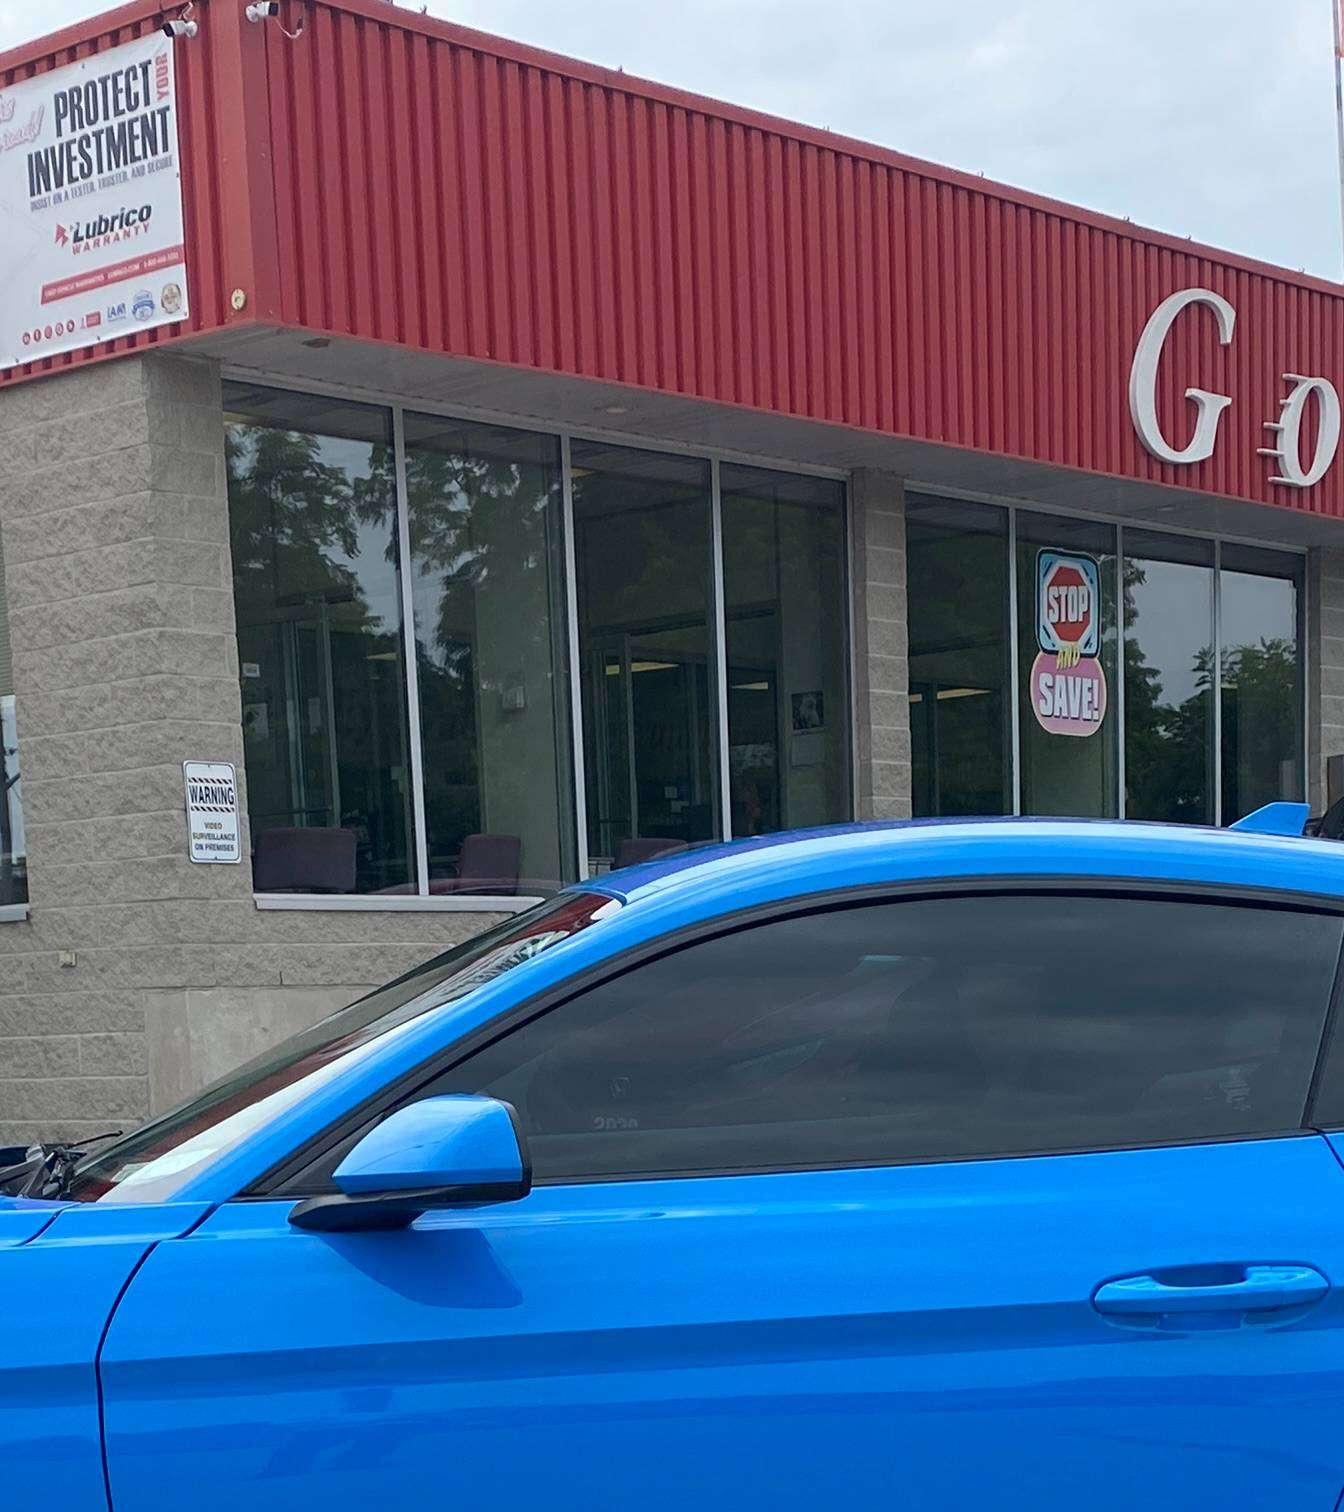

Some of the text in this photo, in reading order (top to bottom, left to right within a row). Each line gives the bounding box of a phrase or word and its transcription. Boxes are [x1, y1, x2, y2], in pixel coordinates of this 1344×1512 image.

[155, 52, 170, 101] YOUR
[54, 59, 152, 138] PROTECT
[27, 105, 171, 198] INVESTMENT
[72, 204, 152, 244] Lubrico
[72, 223, 151, 256] WARRANTY
[1048, 585, 1090, 623] STOP
[1057, 643, 1081, 671] AND
[1038, 672, 1100, 722] SAVE!
[189, 785, 235, 805] WARNING
[192, 832, 236, 841] SURVEILLANCE
[204, 822, 223, 830] VIDEO
[194, 843, 235, 852] ON PREMISES
